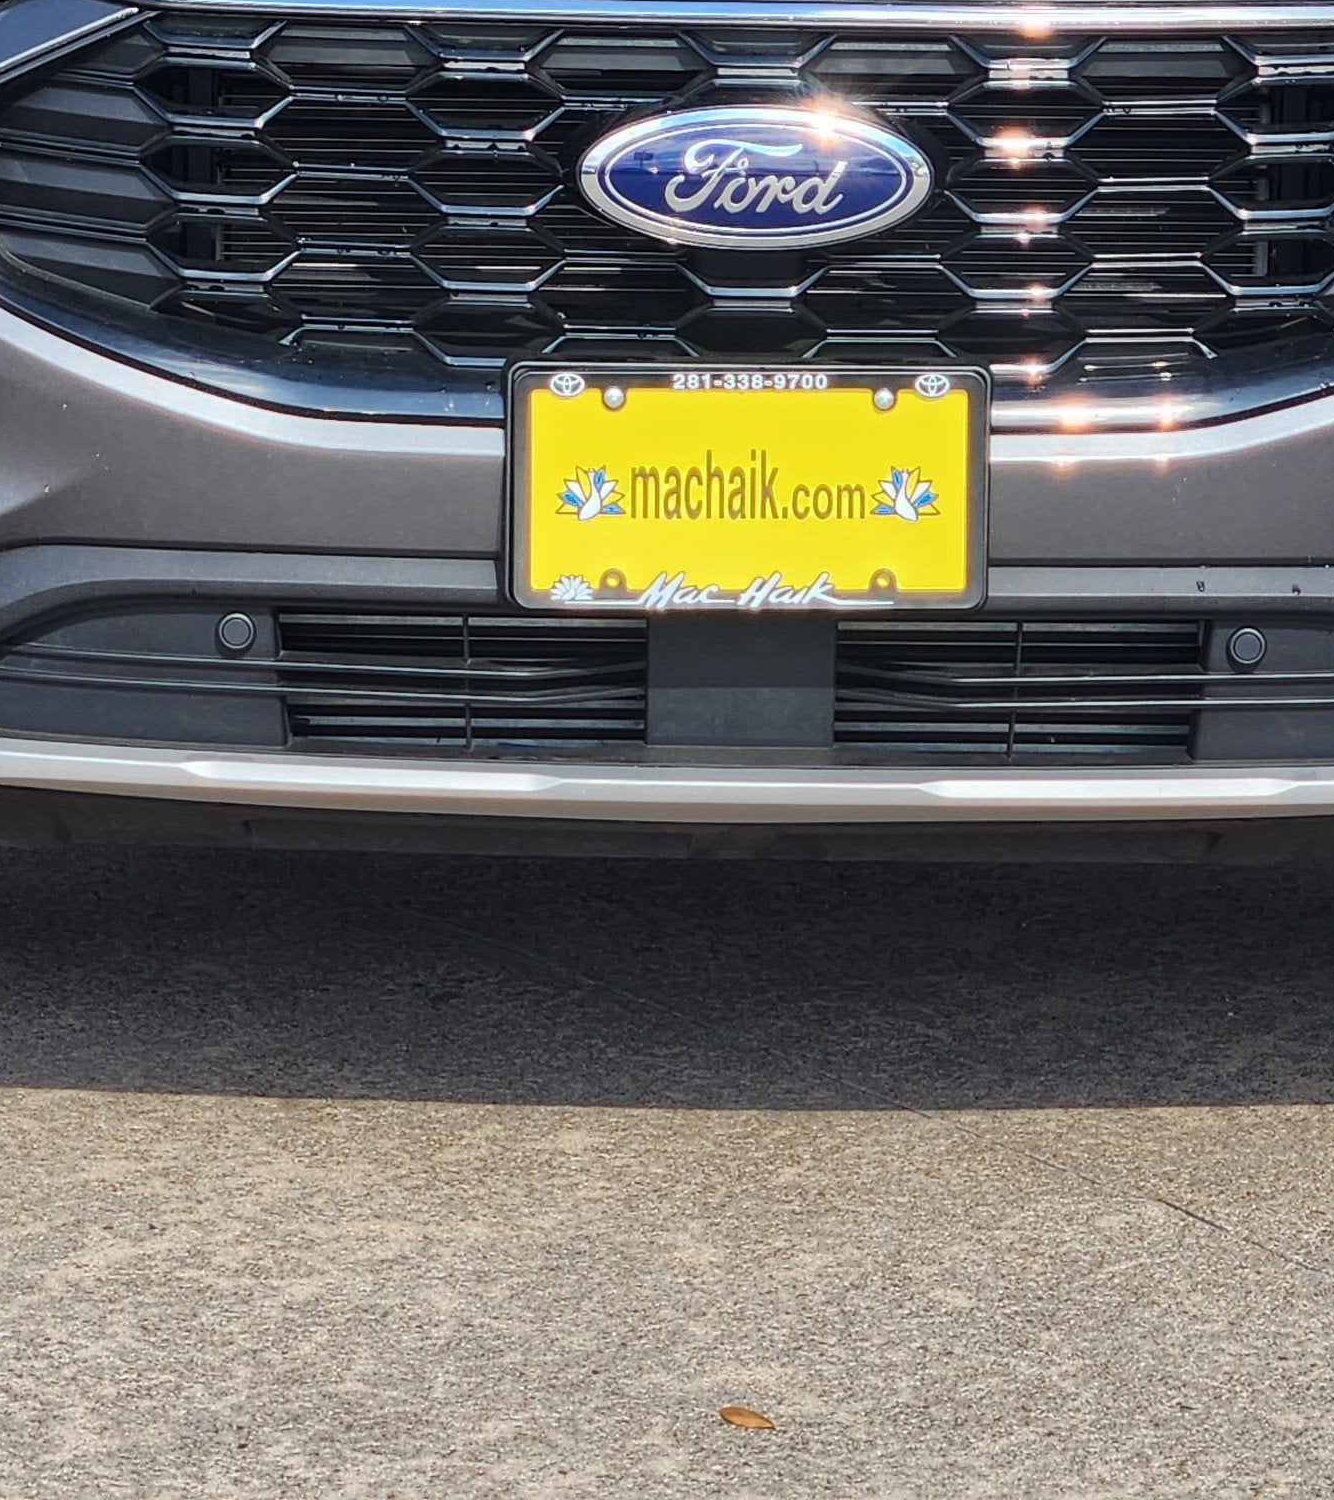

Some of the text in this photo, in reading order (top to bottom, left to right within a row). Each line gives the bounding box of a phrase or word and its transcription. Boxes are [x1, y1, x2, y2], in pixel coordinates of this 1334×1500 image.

[664, 138, 849, 215] Ford
[671, 373, 828, 391] 281-338-9700
[630, 449, 867, 520] machaik.com
[637, 571, 841, 612] Mac Haik
